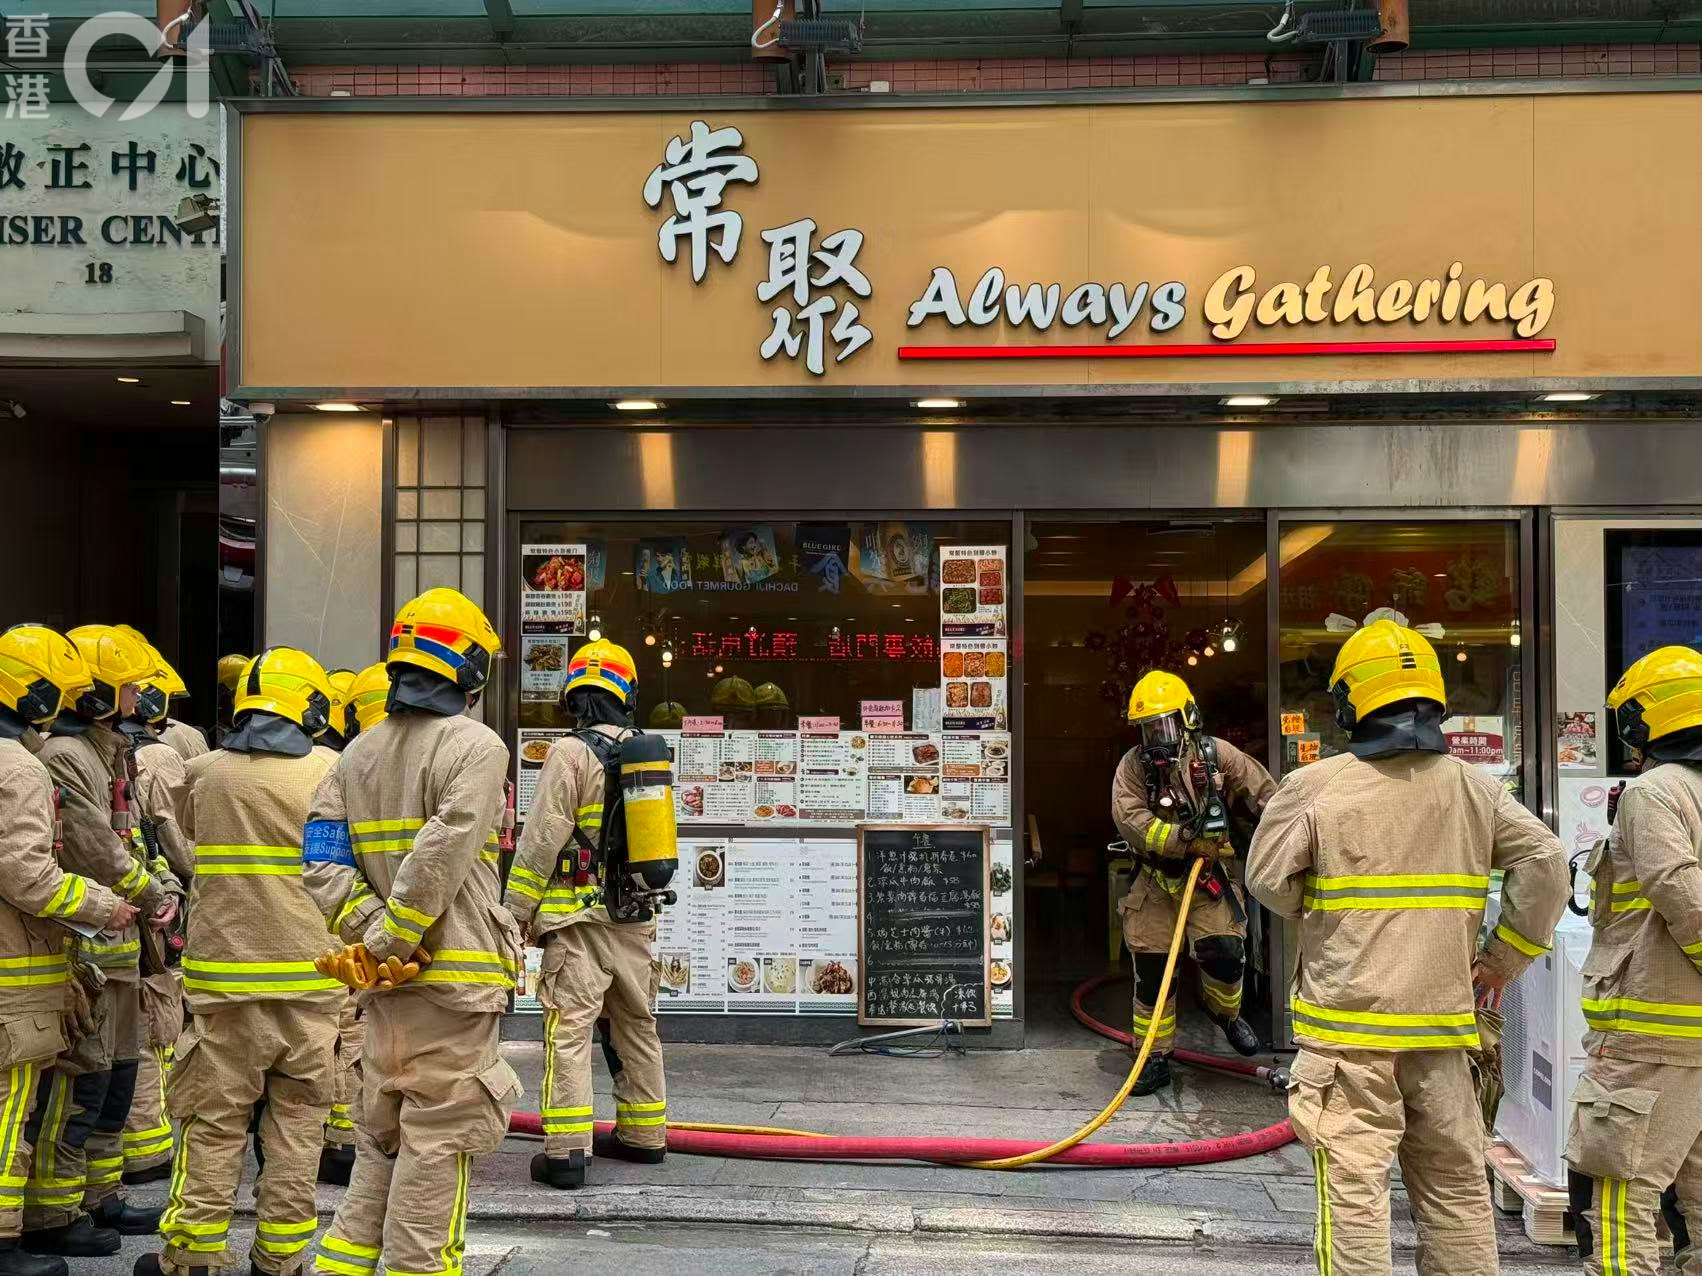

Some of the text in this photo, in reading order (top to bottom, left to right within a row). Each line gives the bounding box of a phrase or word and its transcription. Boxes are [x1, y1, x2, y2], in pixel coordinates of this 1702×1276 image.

[84, 262, 113, 284] 18
[905, 260, 1556, 342] Always Gathering
[1451, 736, 1488, 746] 營業時間
